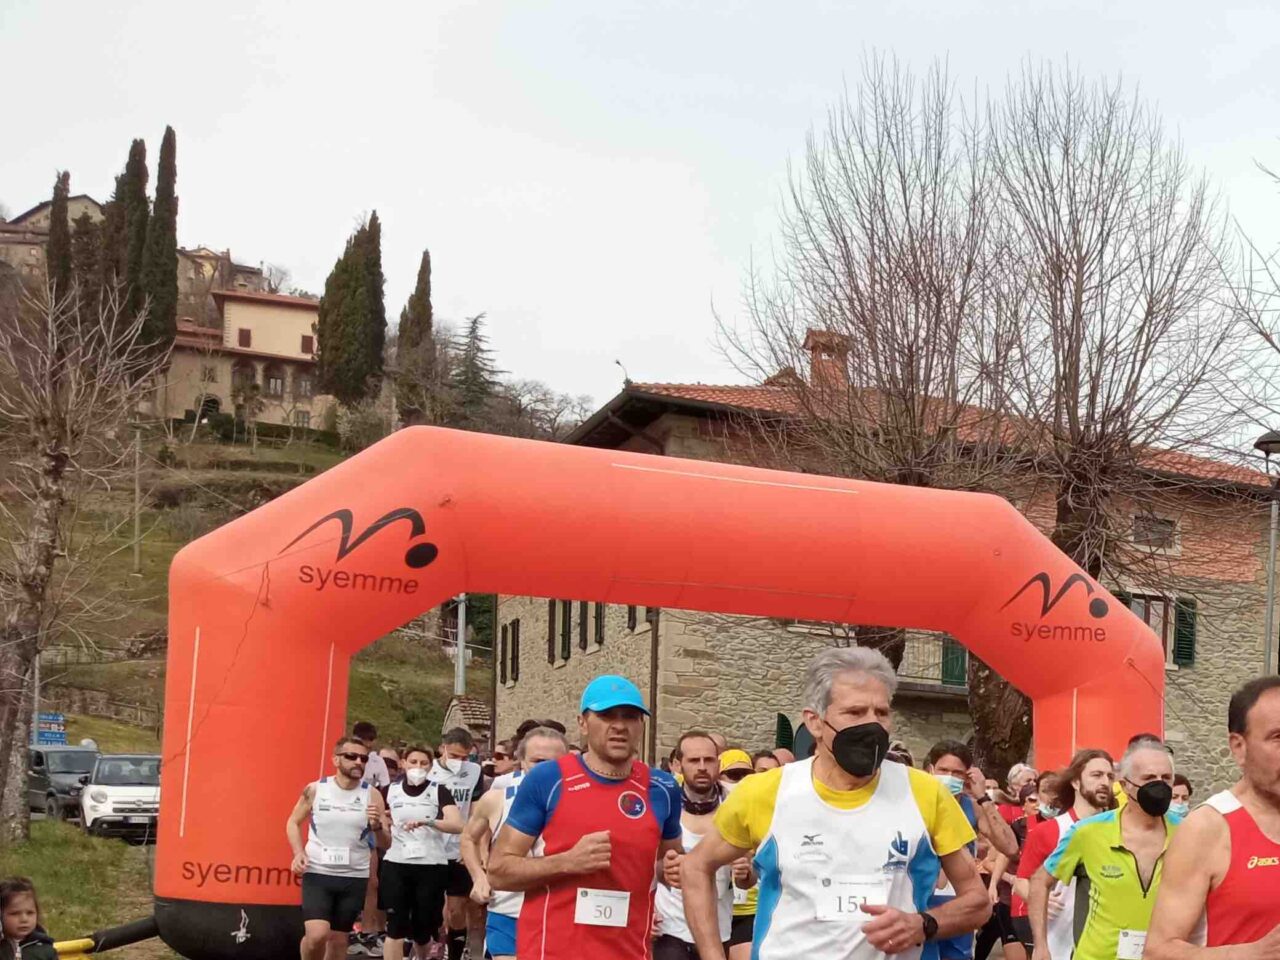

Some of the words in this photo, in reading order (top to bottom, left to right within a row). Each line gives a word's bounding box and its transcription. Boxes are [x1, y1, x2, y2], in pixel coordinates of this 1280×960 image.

[299, 565, 419, 594] syemme
[1010, 622, 1106, 642] syemme
[593, 904, 613, 920] 50
